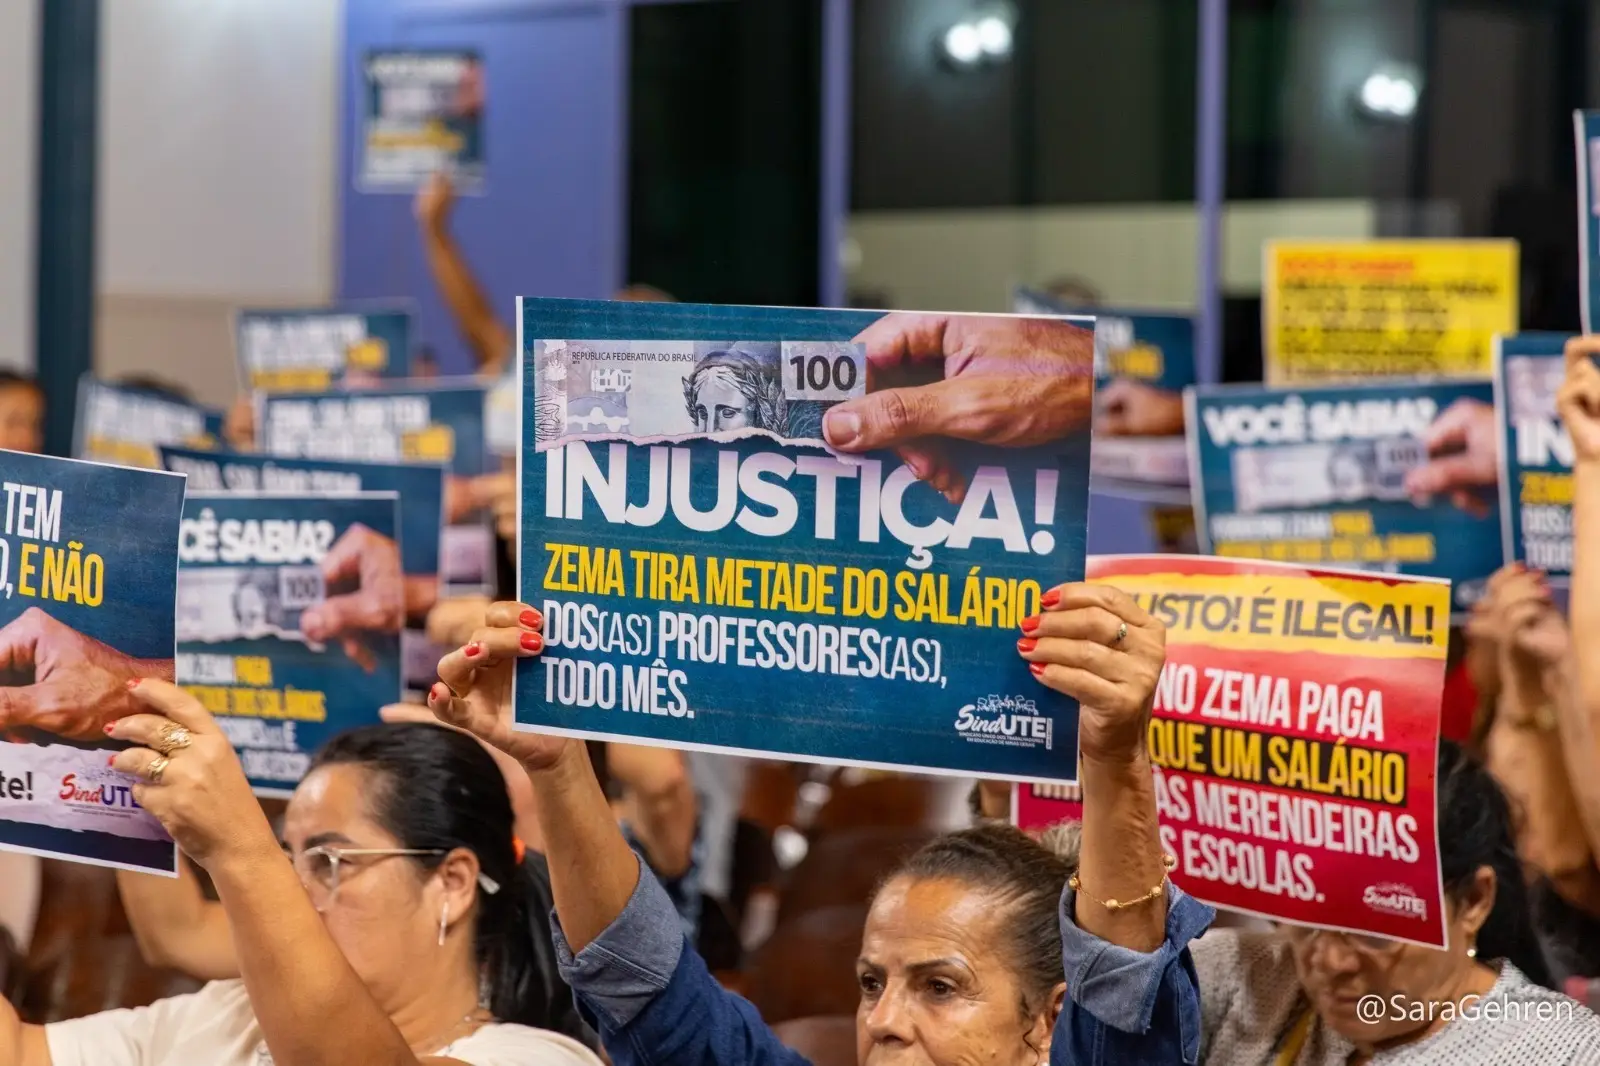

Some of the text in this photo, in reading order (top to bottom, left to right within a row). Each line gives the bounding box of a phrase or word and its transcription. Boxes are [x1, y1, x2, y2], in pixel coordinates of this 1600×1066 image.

[612, 352, 656, 362] FEDERATIVA
[658, 353, 670, 362] DO
[671, 353, 697, 362] BRASIL
[789, 354, 857, 392] 100
[1203, 395, 1305, 446] VOCÊ
[3, 481, 63, 543] TEM
[545, 441, 1059, 569] INJUSTIÇA!
[220, 518, 336, 563] SABIA?
[18, 542, 39, 597] E
[41, 540, 104, 607] NÃO
[543, 543, 1041, 631] ZEMA TIRA METADE DO SALÁRIO
[543, 600, 947, 689] DOS(AS) PROFESSORES(AS),
[1250, 585, 1277, 635] É
[1282, 600, 1435, 645] ILEGAL!
[541, 656, 695, 719] TODO MÊS.
[1201, 667, 1292, 729] ZEMA
[1299, 678, 1384, 742] PAGA
[954, 703, 1047, 739] SindUTE
[1149, 717, 1406, 803] QUE UM SALÁRIO
[1194, 780, 1420, 864] MERENDEIRAS
[1183, 829, 1326, 902] ESCOLAS.
